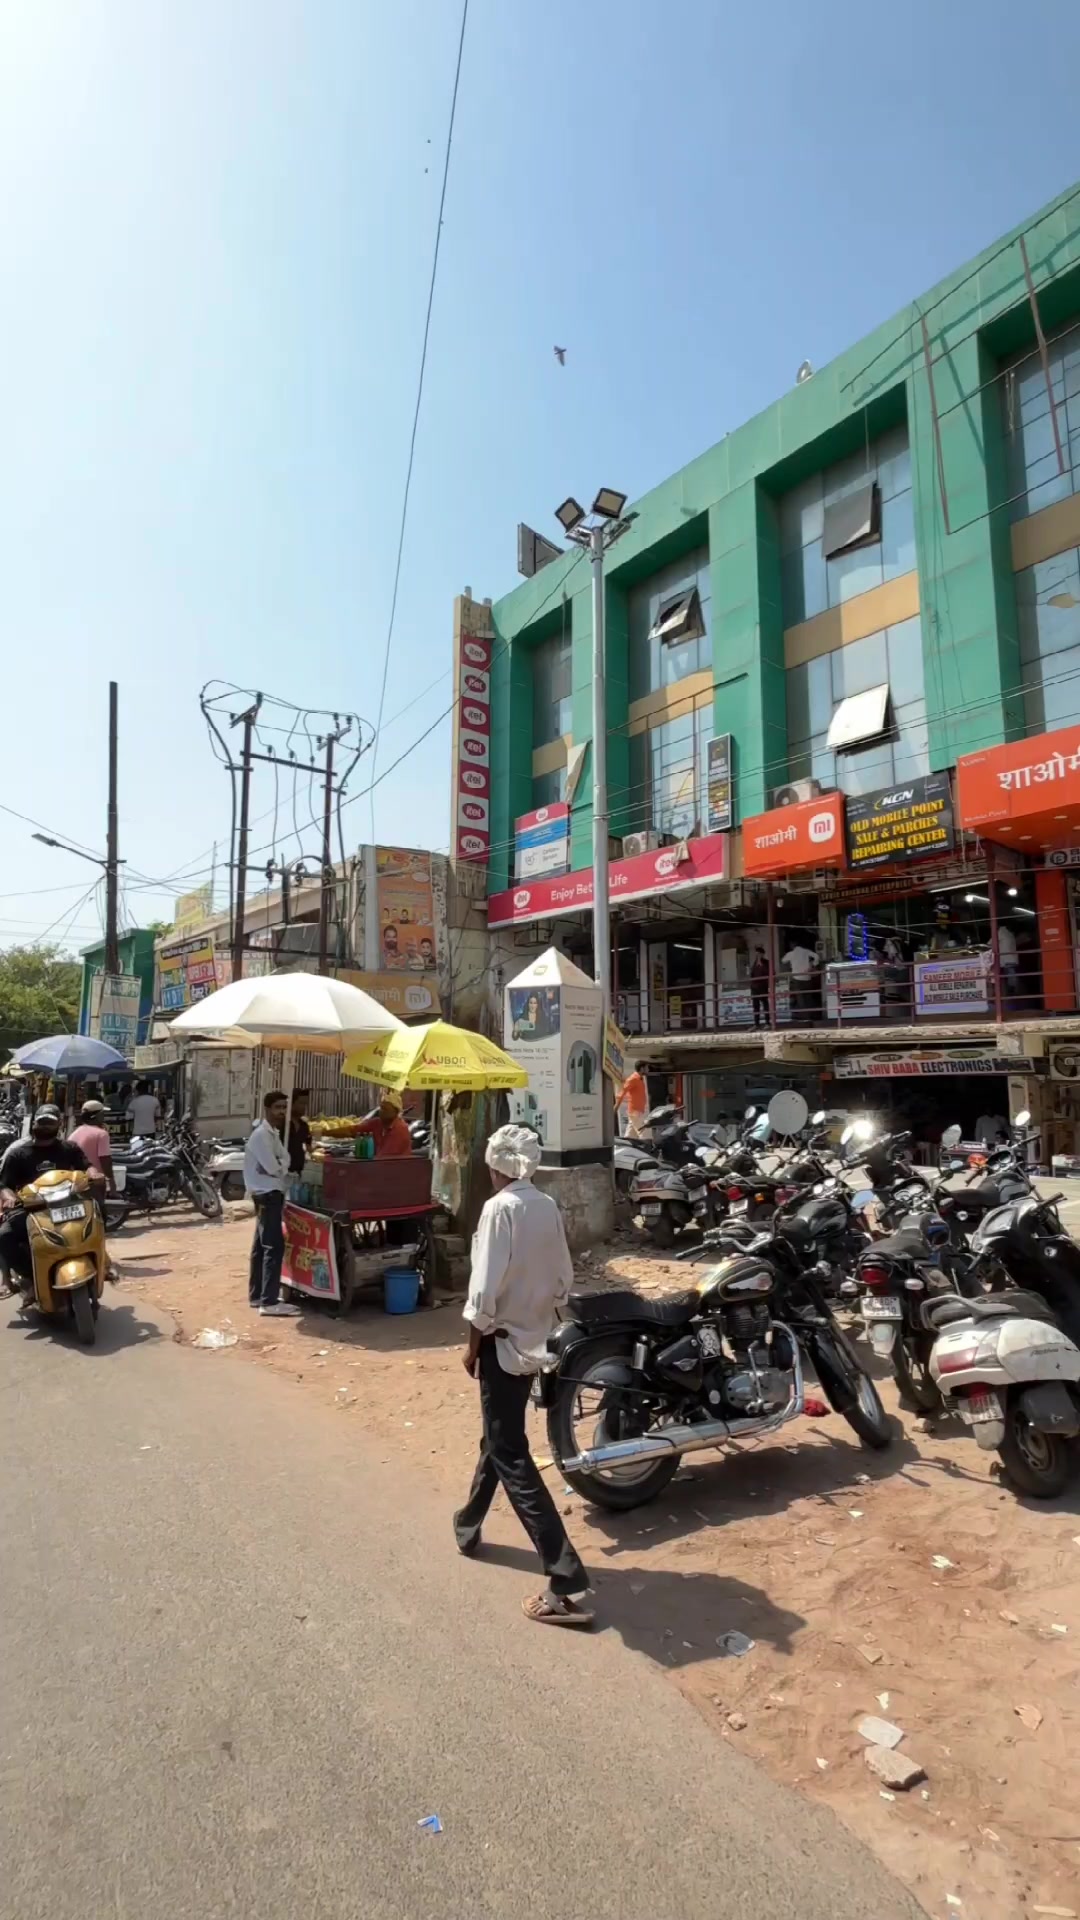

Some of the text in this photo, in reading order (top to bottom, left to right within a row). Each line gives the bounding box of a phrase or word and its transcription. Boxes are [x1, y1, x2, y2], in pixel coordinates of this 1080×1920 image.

[467, 741, 482, 753] itel
[466, 773, 482, 786] itel
[882, 789, 914, 806] KGN
[466, 805, 482, 818] itel
[850, 819, 869, 833] OLD
[871, 808, 909, 828] MOBILE
[911, 799, 945, 817] POINT
[754, 825, 797, 848] शाओमी
[856, 816, 939, 845] SALE & PARCHES
[852, 838, 905, 860] REPAIRING
[907, 828, 947, 847] CENTER
[551, 886, 574, 903] Enjoy
[609, 873, 628, 887] Life
[867, 1063, 890, 1075] SHIV
[892, 1061, 920, 1074] BABA
[921, 1058, 993, 1073] ELECTRONICS
